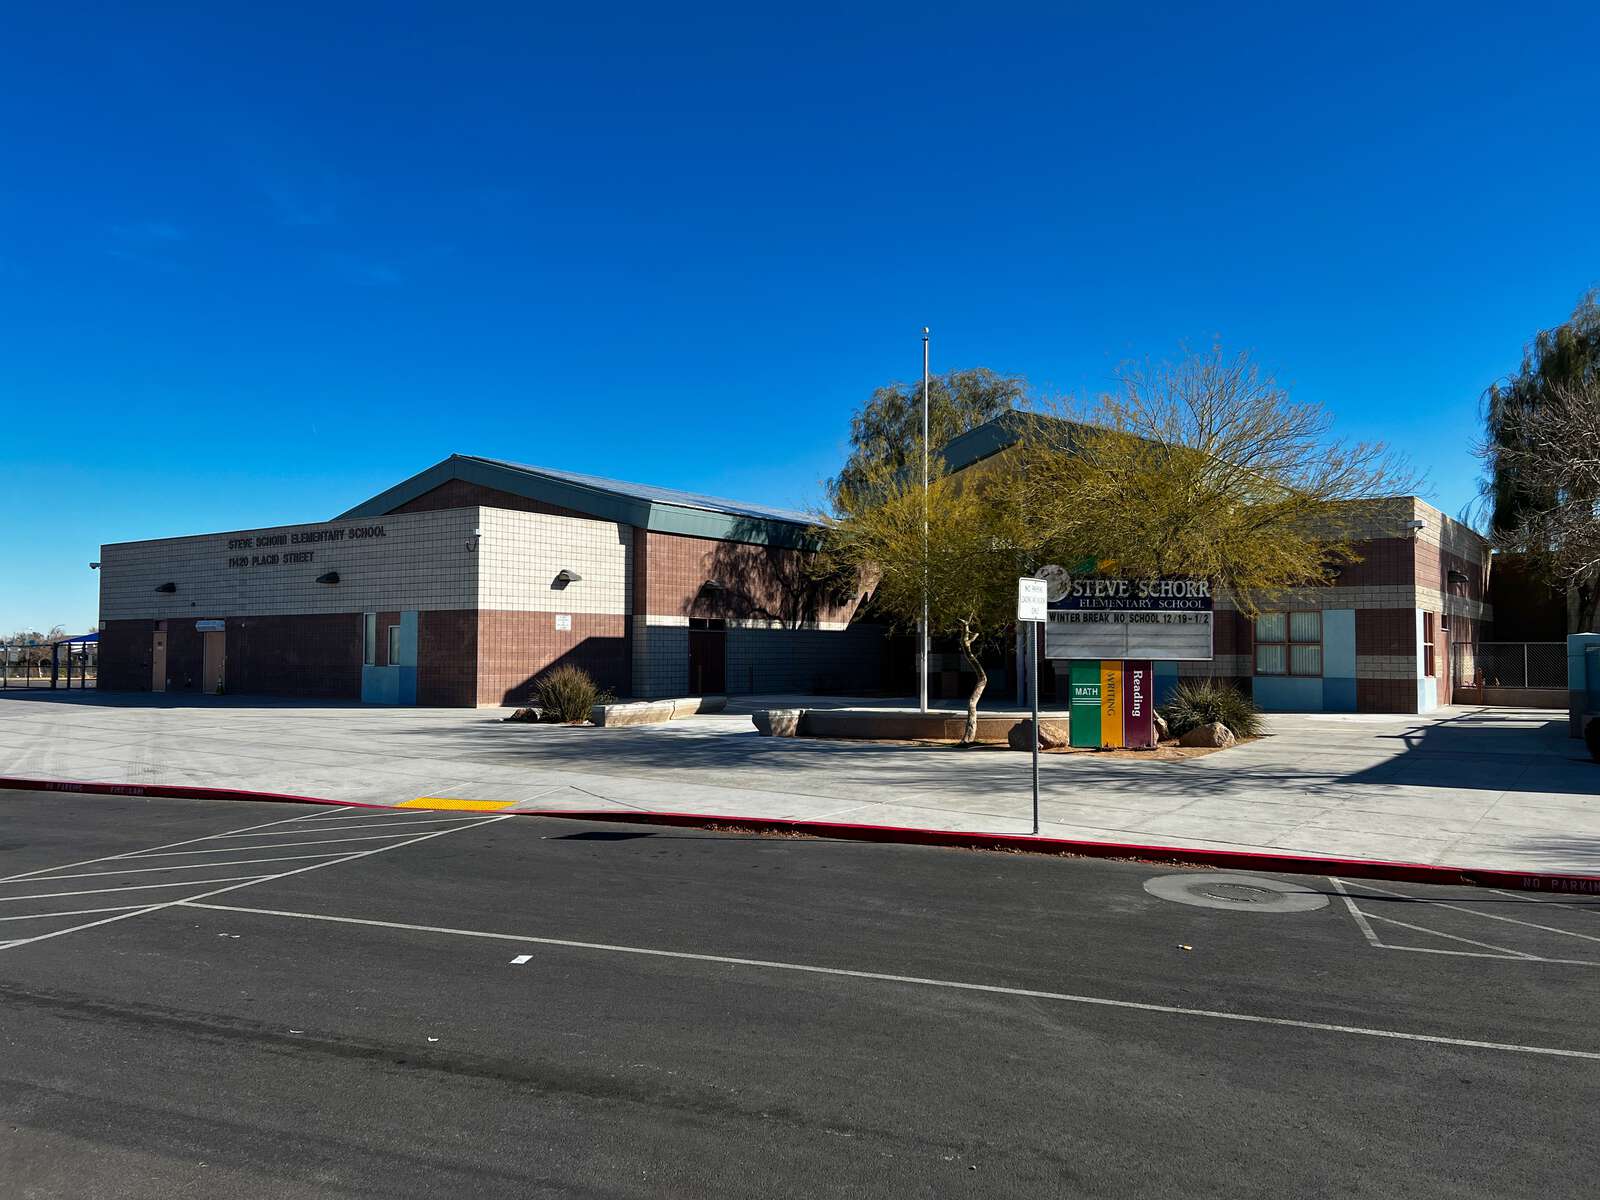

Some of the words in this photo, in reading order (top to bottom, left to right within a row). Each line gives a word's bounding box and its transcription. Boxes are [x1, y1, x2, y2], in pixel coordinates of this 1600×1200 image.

[228, 538, 252, 549] STEVE
[291, 529, 344, 544] ELEMENTARY
[348, 526, 386, 539] SCHOOL
[252, 554, 279, 566] PLACID
[283, 552, 314, 564] STREET
[1072, 580, 1129, 597] STEVE
[1138, 580, 1211, 598] SCHORR
[1080, 599, 1152, 609] ELEMENTARY
[1159, 600, 1205, 609] SCHOOL
[1049, 613, 1081, 622] WINTER
[1083, 613, 1109, 623] BREAK
[1114, 614, 1125, 623] NO
[1129, 614, 1160, 623] SCHOOL
[1075, 688, 1098, 696] MATH
[1107, 673, 1116, 717] WRITING
[1132, 670, 1144, 717] Reading
[1523, 878, 1540, 889] NO
